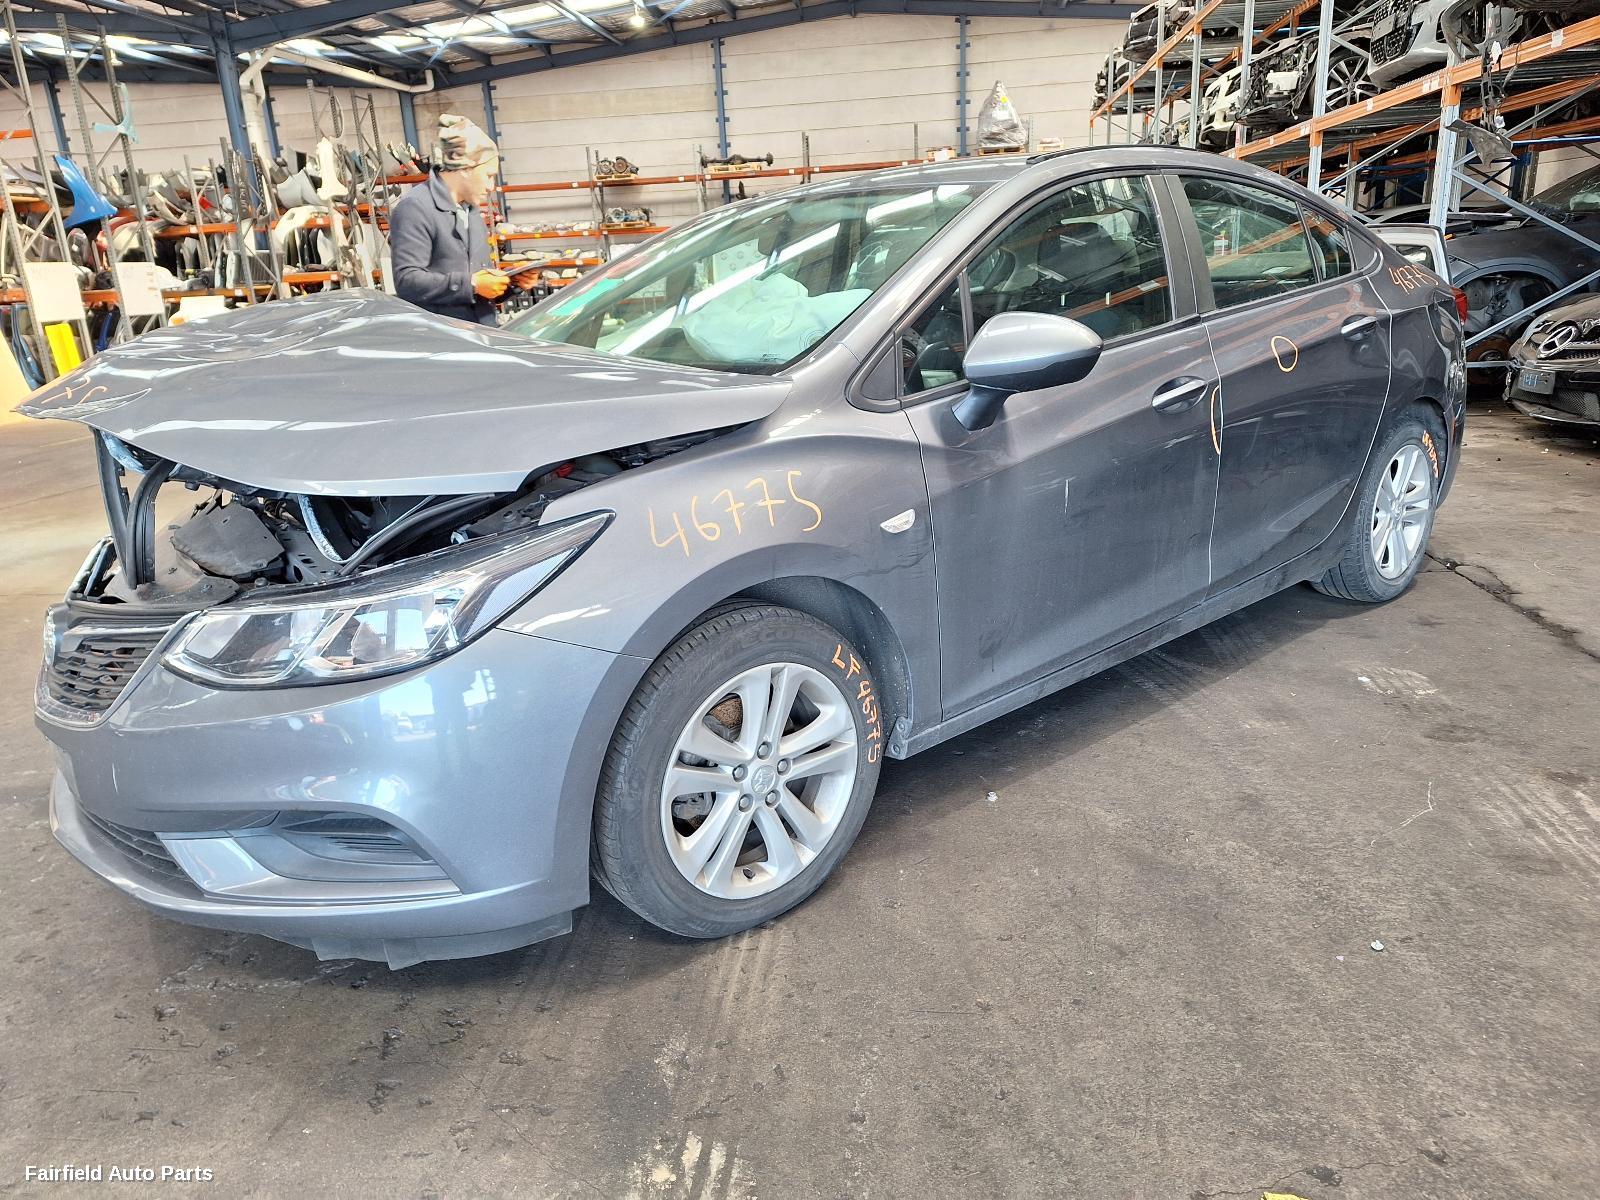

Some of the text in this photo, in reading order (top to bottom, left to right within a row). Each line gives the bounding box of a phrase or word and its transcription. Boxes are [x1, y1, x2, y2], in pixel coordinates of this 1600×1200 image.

[647, 470, 822, 557] 46775
[831, 644, 882, 763] LF 46775
